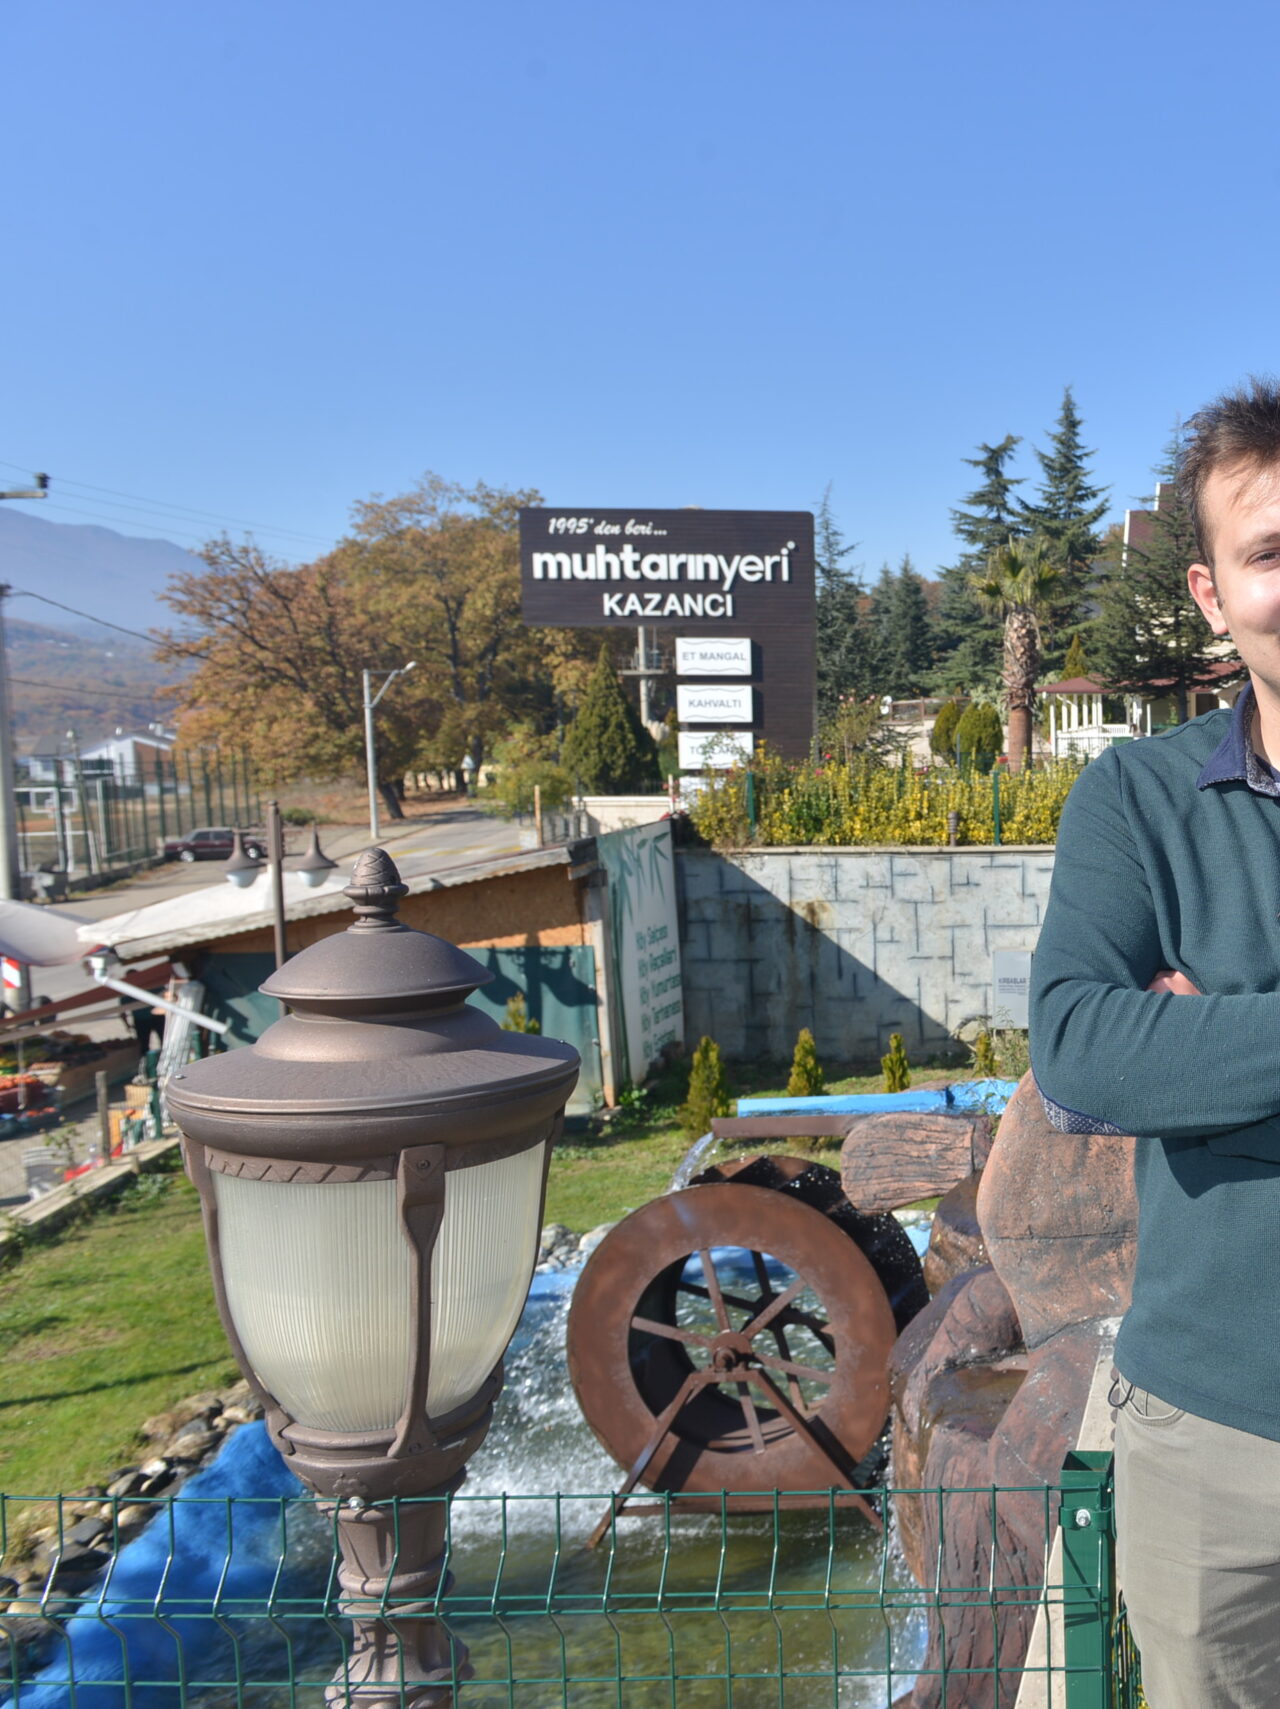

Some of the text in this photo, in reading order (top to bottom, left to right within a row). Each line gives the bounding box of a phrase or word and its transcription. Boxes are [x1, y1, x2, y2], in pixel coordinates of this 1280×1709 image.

[603, 593, 733, 616] KAZANCI
[682, 652, 747, 661] ET MANGAL
[688, 699, 742, 708] KAHVALTI
